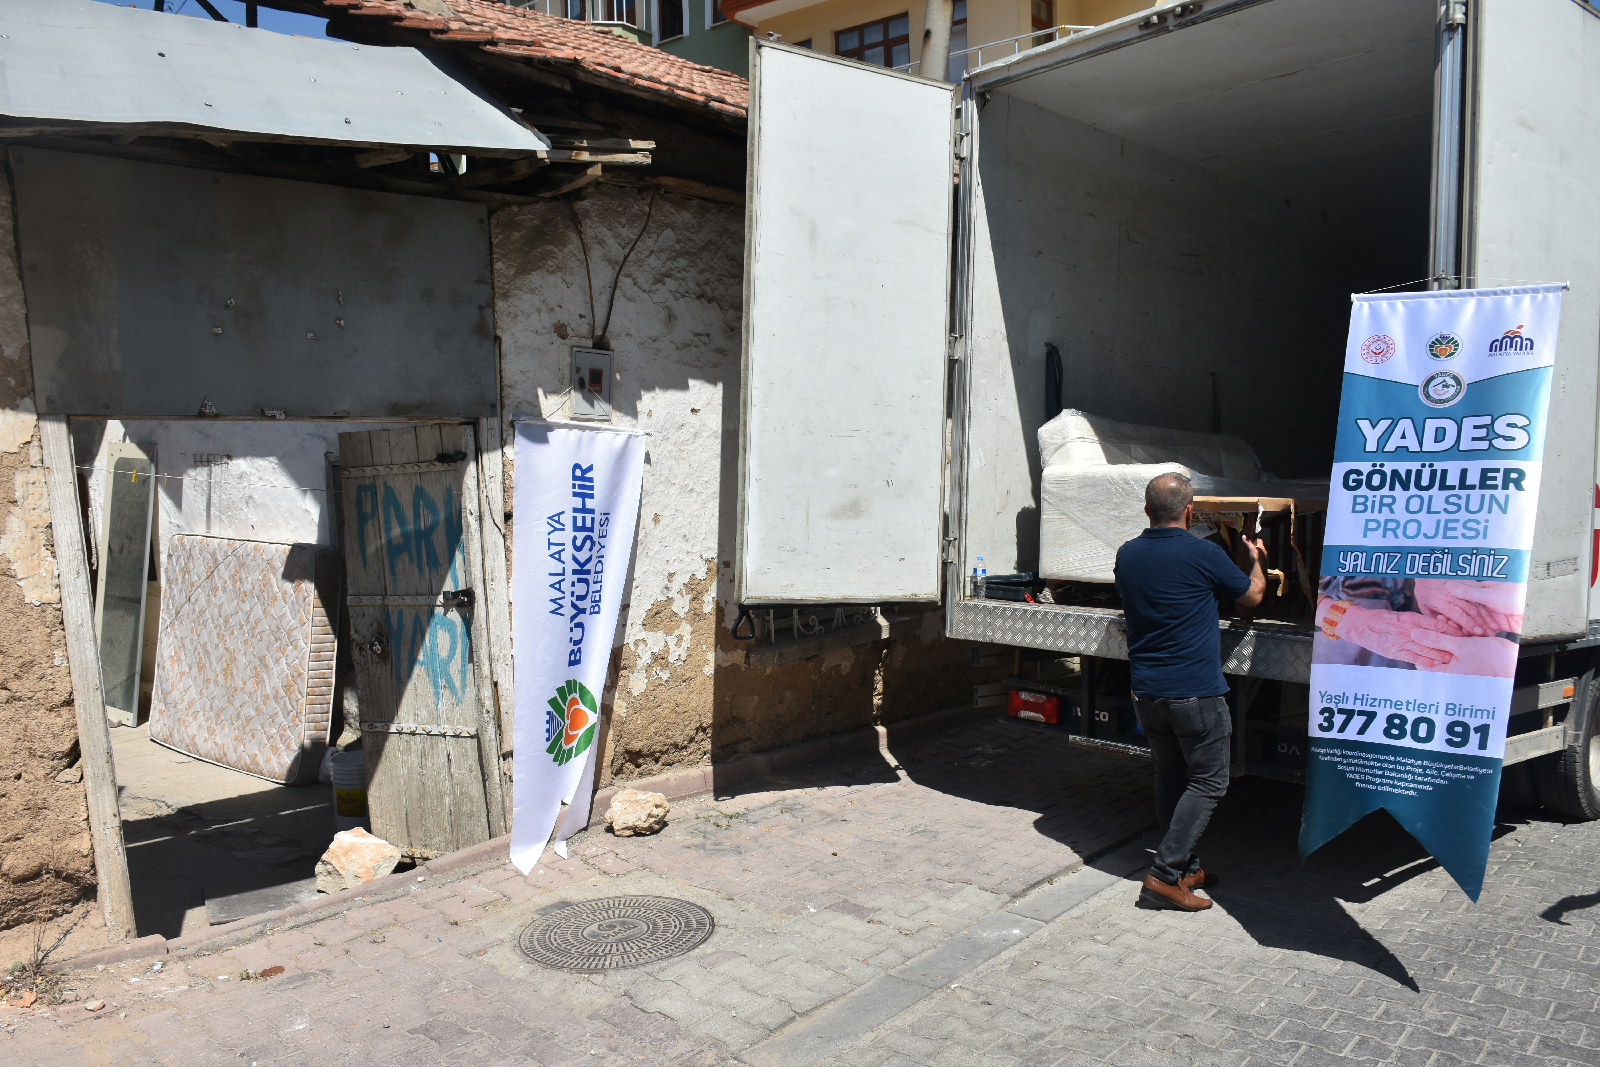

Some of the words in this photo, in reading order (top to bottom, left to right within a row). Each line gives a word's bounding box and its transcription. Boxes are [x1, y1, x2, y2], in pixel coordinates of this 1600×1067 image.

[1355, 413, 1532, 453] YADES
[1342, 463, 1527, 492] GÖNÜLLER
[1405, 493, 1510, 515] OLSUN
[546, 510, 566, 617] MALATYA
[1338, 551, 1402, 574] YALNIZ
[1318, 690, 1350, 708] Yaşlı
[1353, 692, 1440, 716] Hizmetleri
[1444, 702, 1496, 721] Birimi
[1317, 706, 1378, 736] 377
[1382, 713, 1437, 744] 80
[1444, 720, 1491, 751] 91
